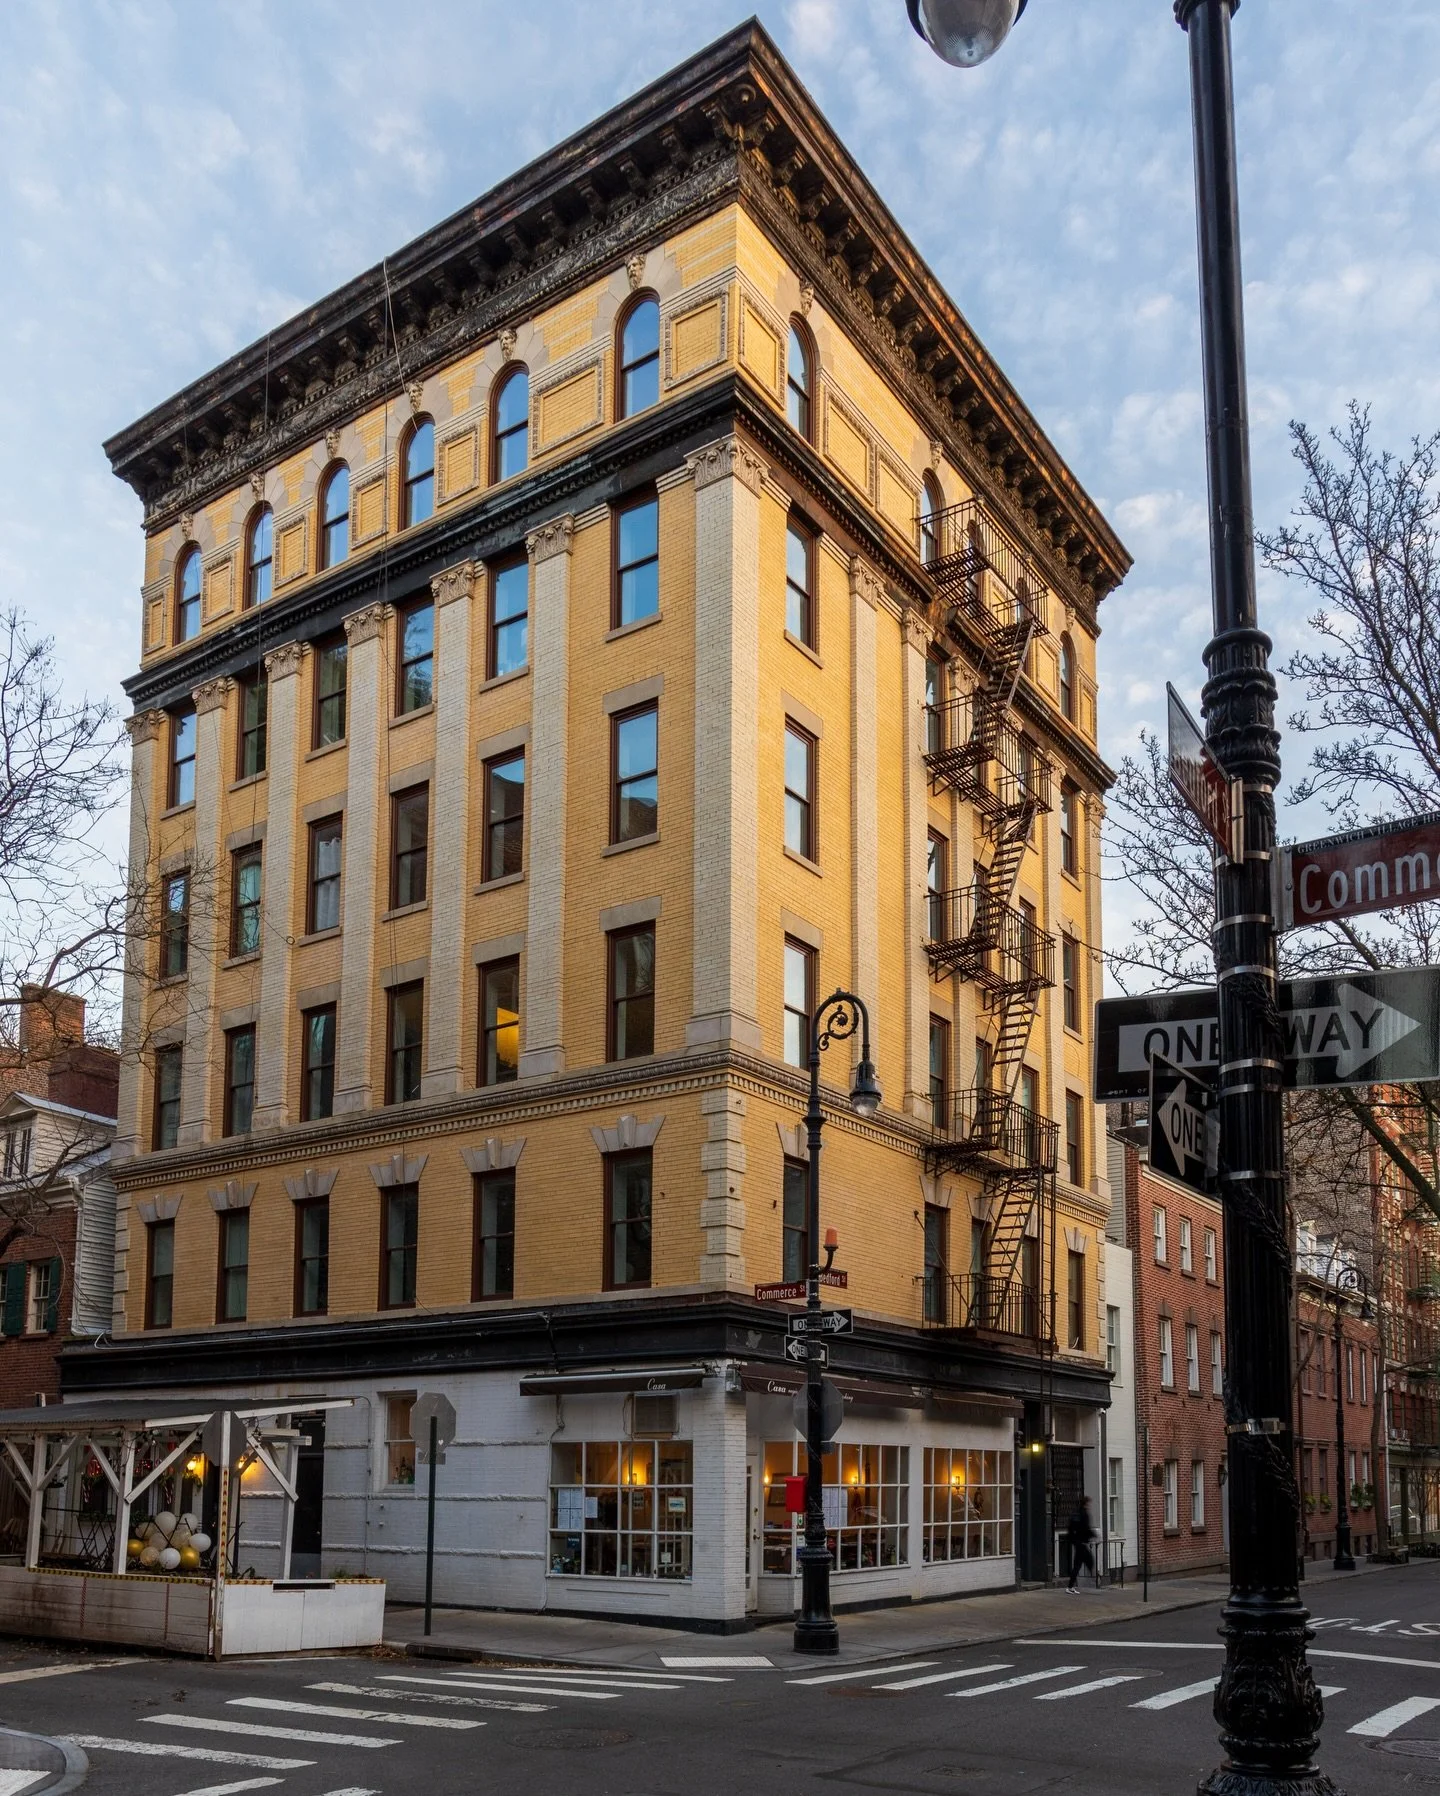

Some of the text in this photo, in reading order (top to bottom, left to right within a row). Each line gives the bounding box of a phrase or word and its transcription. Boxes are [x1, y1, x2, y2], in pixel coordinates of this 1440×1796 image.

[1297, 830, 1365, 854] GREENWICH
[1369, 818, 1419, 837] VILLAGE
[1300, 852, 1440, 914] Comm
[1281, 1008, 1385, 1055] WAY
[1170, 1102, 1205, 1159] ONE
[756, 1287, 797, 1300] Commerce
[823, 1317, 842, 1327] WAY
[767, 1380, 786, 1393] Casa
